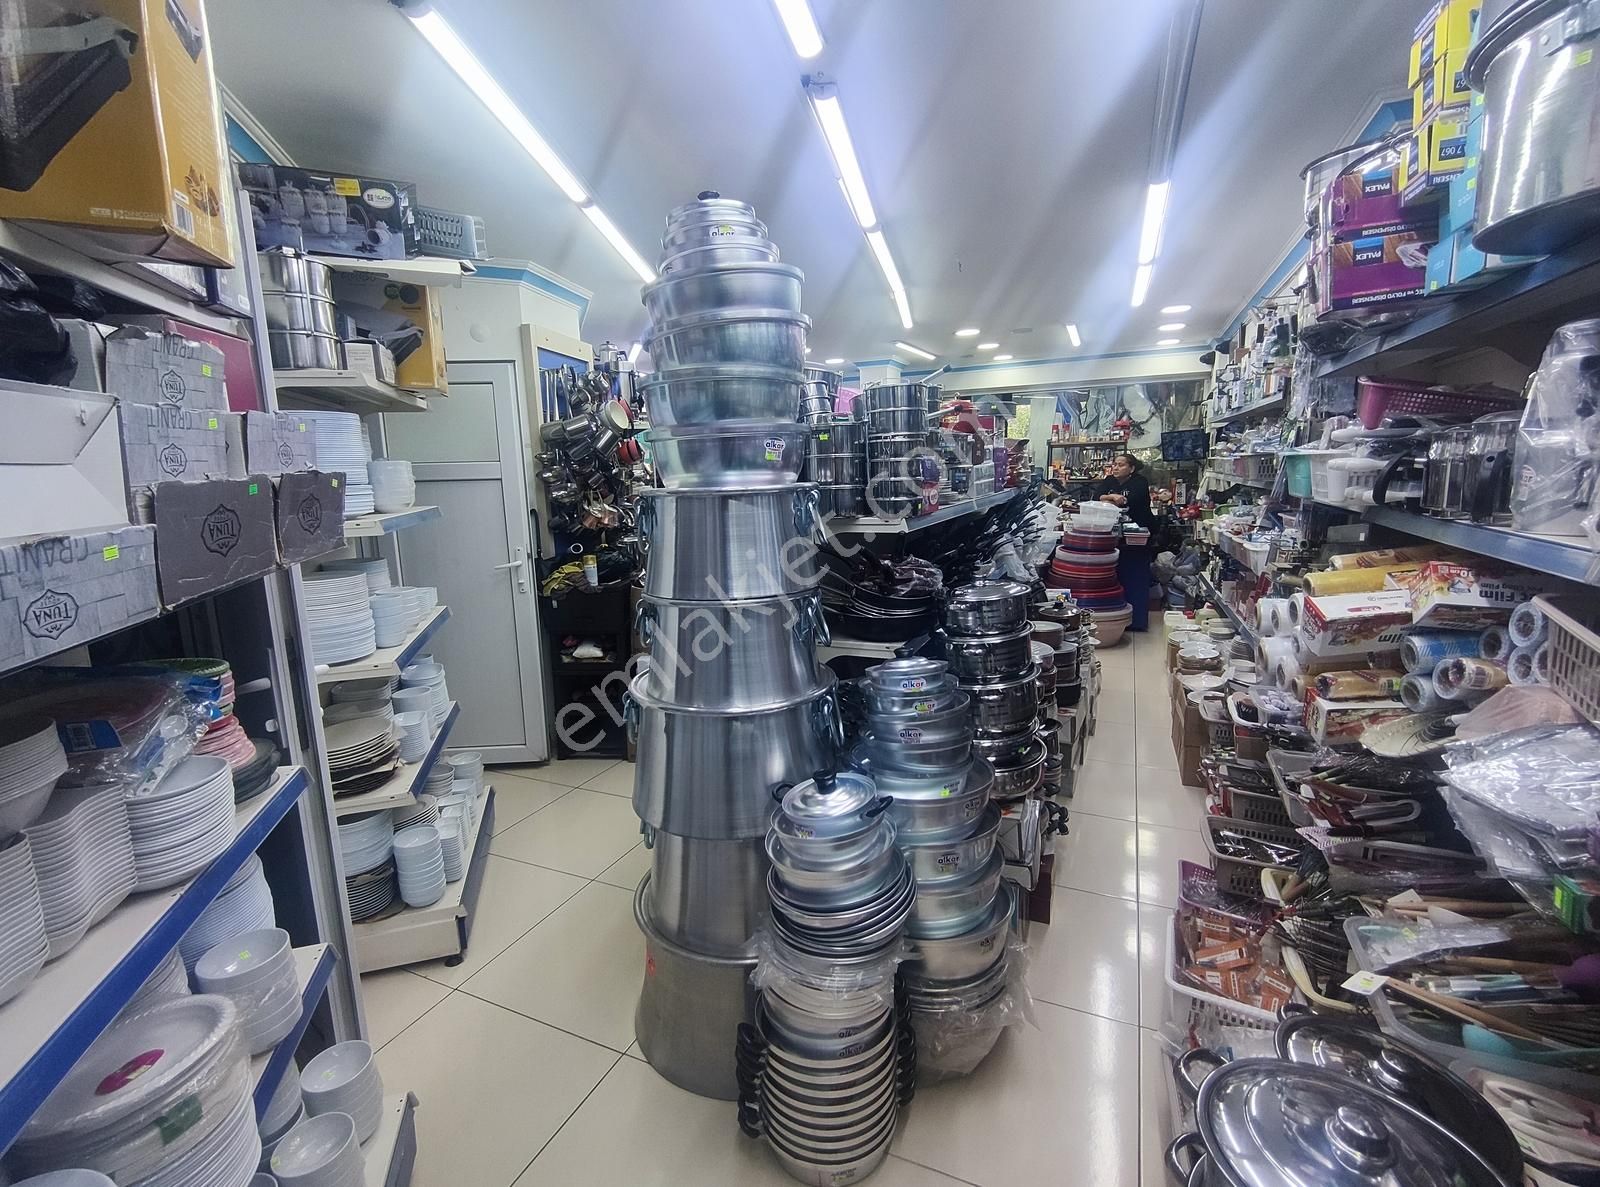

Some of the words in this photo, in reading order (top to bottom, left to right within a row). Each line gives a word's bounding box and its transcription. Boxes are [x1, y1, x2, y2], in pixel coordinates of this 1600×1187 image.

[1441, 146, 1456, 156] 067
[1364, 182, 1391, 193] PALEX
[1355, 250, 1382, 261] PALEX
[1387, 291, 1406, 300] FOLYO
[164, 379, 183, 395] TUNA
[164, 454, 184, 468] TUNA
[301, 507, 320, 522] TUNA
[207, 520, 237, 542] TUNA
[1479, 590, 1515, 602] Film
[32, 602, 73, 627] TUNA
[1378, 633, 1402, 644] ilm
